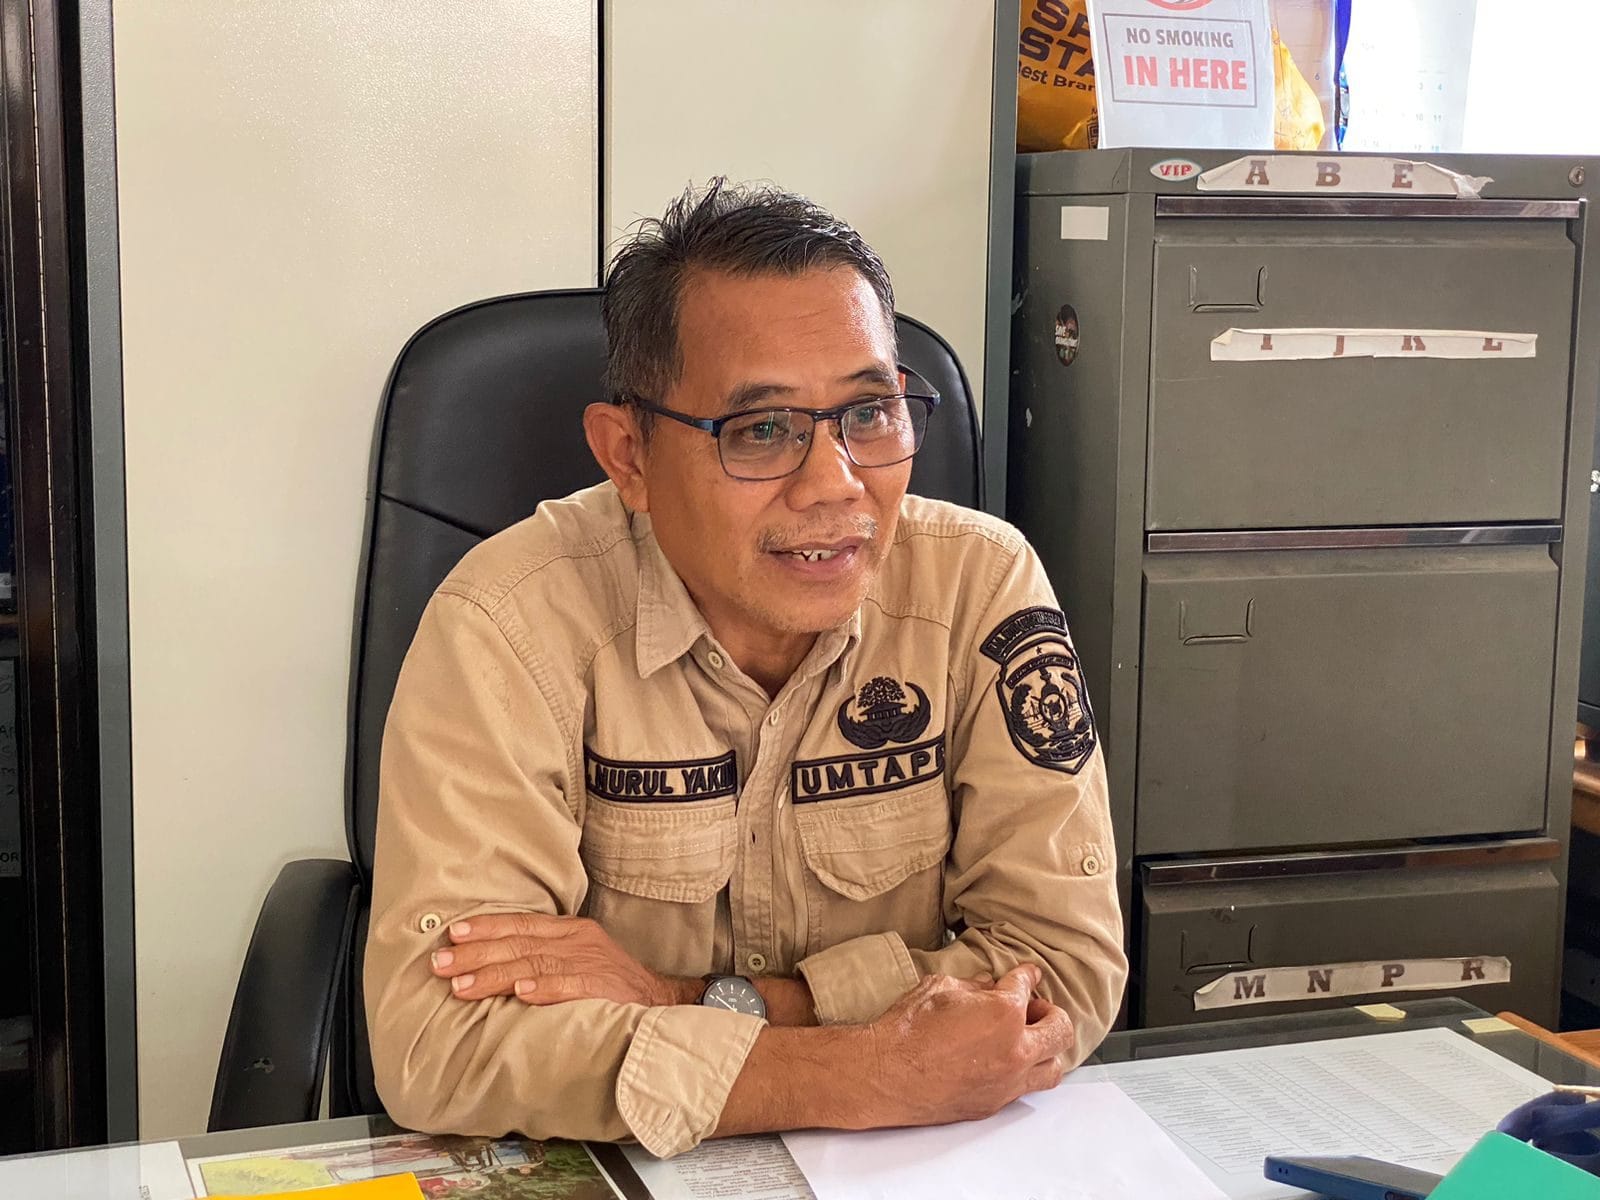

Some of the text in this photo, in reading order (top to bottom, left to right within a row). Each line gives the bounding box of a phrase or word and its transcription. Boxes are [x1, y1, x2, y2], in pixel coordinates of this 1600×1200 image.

[1126, 28, 1234, 48] NO SMOKING
[1018, 60, 1048, 85] est
[1123, 55, 1248, 90] IN HERE
[1160, 164, 1193, 176] VIP
[1245, 160, 1414, 188] A B E
[595, 763, 673, 795] NURUL
[1233, 958, 1485, 999] M N P R
